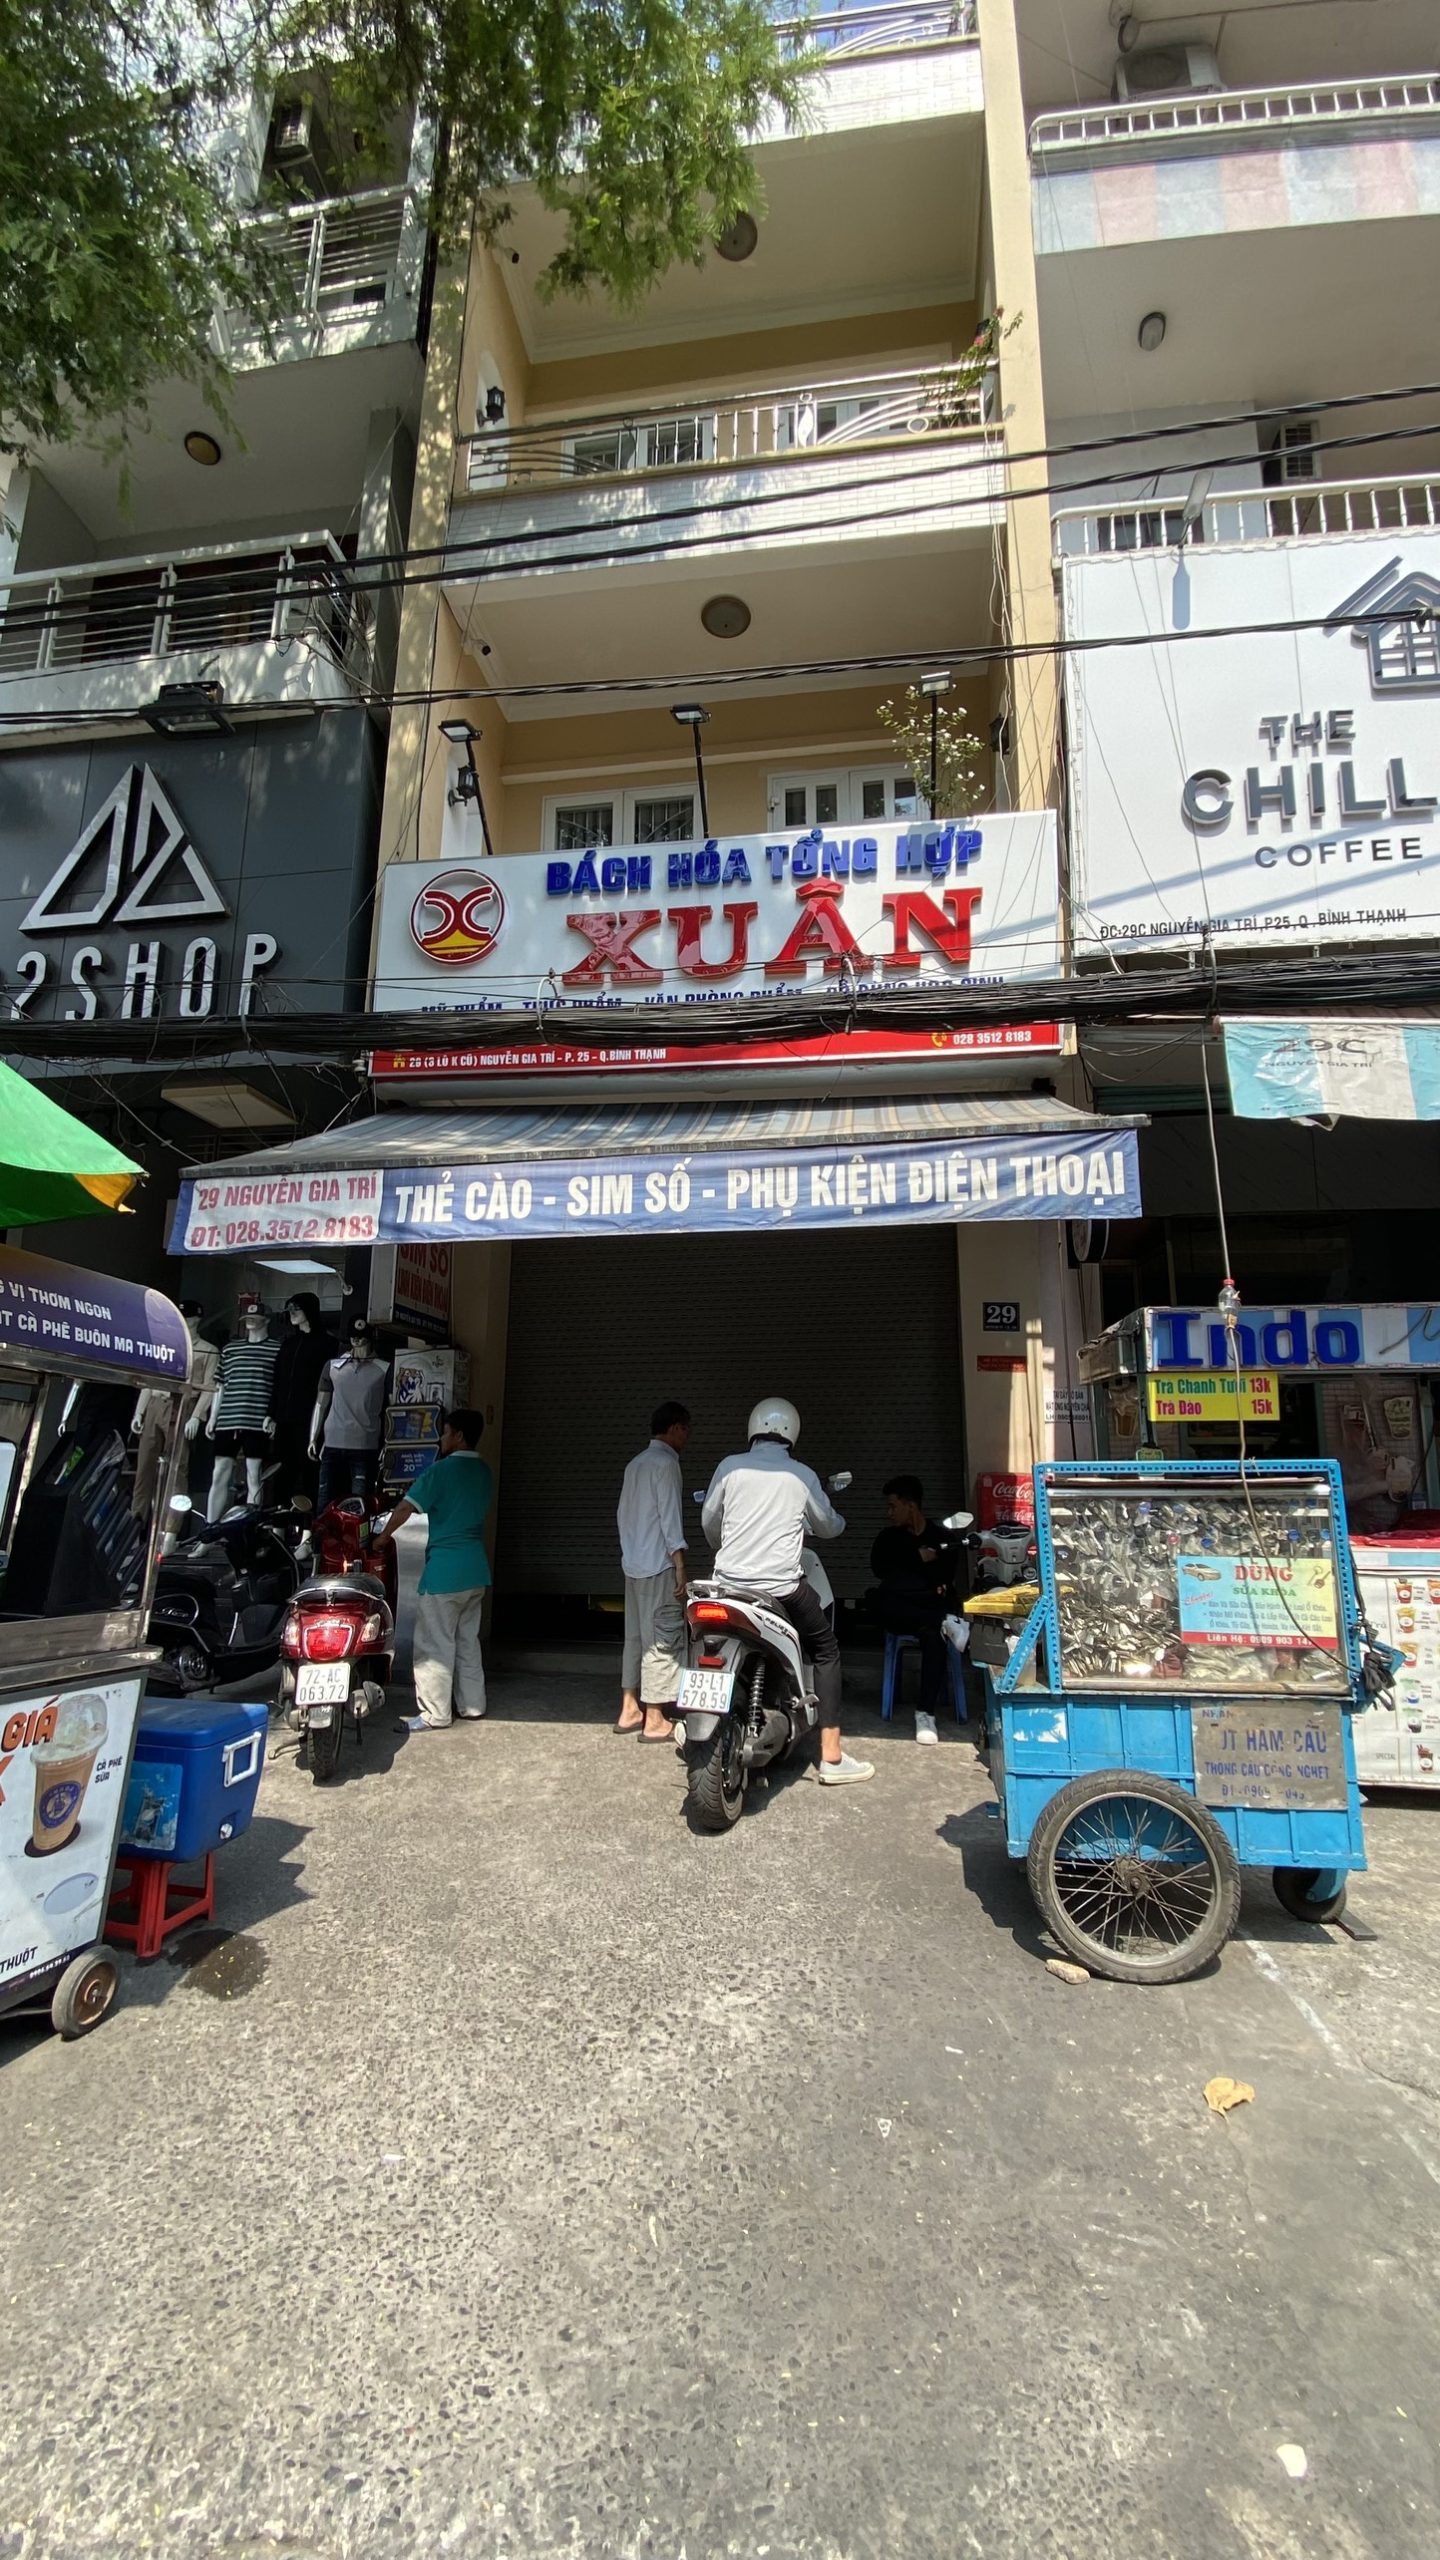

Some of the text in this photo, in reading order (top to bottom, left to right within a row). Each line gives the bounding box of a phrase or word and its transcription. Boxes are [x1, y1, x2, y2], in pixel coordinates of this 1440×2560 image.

[1260, 709, 1356, 749] THE
[1182, 757, 1438, 825] CHILL
[546, 826, 983, 896] BÁCH HÓA TỔNG HỢP
[1254, 837, 1423, 868] COFFEE
[562, 876, 984, 986] XUÂN
[953, 1030, 1032, 1045] 028 3512 8183
[521, 1053, 538, 1065] GIA
[540, 1050, 555, 1063] TRÍ
[577, 1051, 590, 1062] 25
[198, 1187, 219, 1212] 29
[308, 1176, 341, 1204] GIA
[347, 1171, 377, 1202] TRÍ
[395, 1169, 454, 1225] THẺ
[464, 1172, 532, 1222] CÀO
[567, 1174, 634, 1218] SIM
[645, 1157, 694, 1214] SỐ
[727, 1165, 798, 1218] PHỤ
[810, 1154, 896, 1215] KIỆN
[908, 1150, 999, 1211] ĐIỆN
[1009, 1150, 1125, 1206] THOẠI
[190, 1216, 374, 1249] ĐT: 028.3512.8183
[8, 1281, 25, 1303] VỊ
[28, 1287, 71, 1311] THƠM
[74, 1299, 112, 1321] NGON
[987, 1305, 1016, 1324] 29
[18, 1310, 38, 1332] CÀ
[42, 1319, 71, 1340] PHÊ
[74, 1327, 110, 1349] BUÔN
[114, 1336, 134, 1354] MA
[137, 1341, 176, 1364] THUỘT
[1158, 1310, 1360, 1368] Indo
[1177, 1377, 1216, 1394] Chanh
[1250, 1376, 1271, 1393] 13k
[1155, 1398, 1273, 1416] Trà Đào 15k
[306, 1668, 342, 1685] 72-AC
[689, 1672, 725, 1690] 93-L1
[300, 1685, 345, 1702] 063.72
[681, 1689, 728, 1710] 578.59
[1, 1694, 62, 1753] GIÁ
